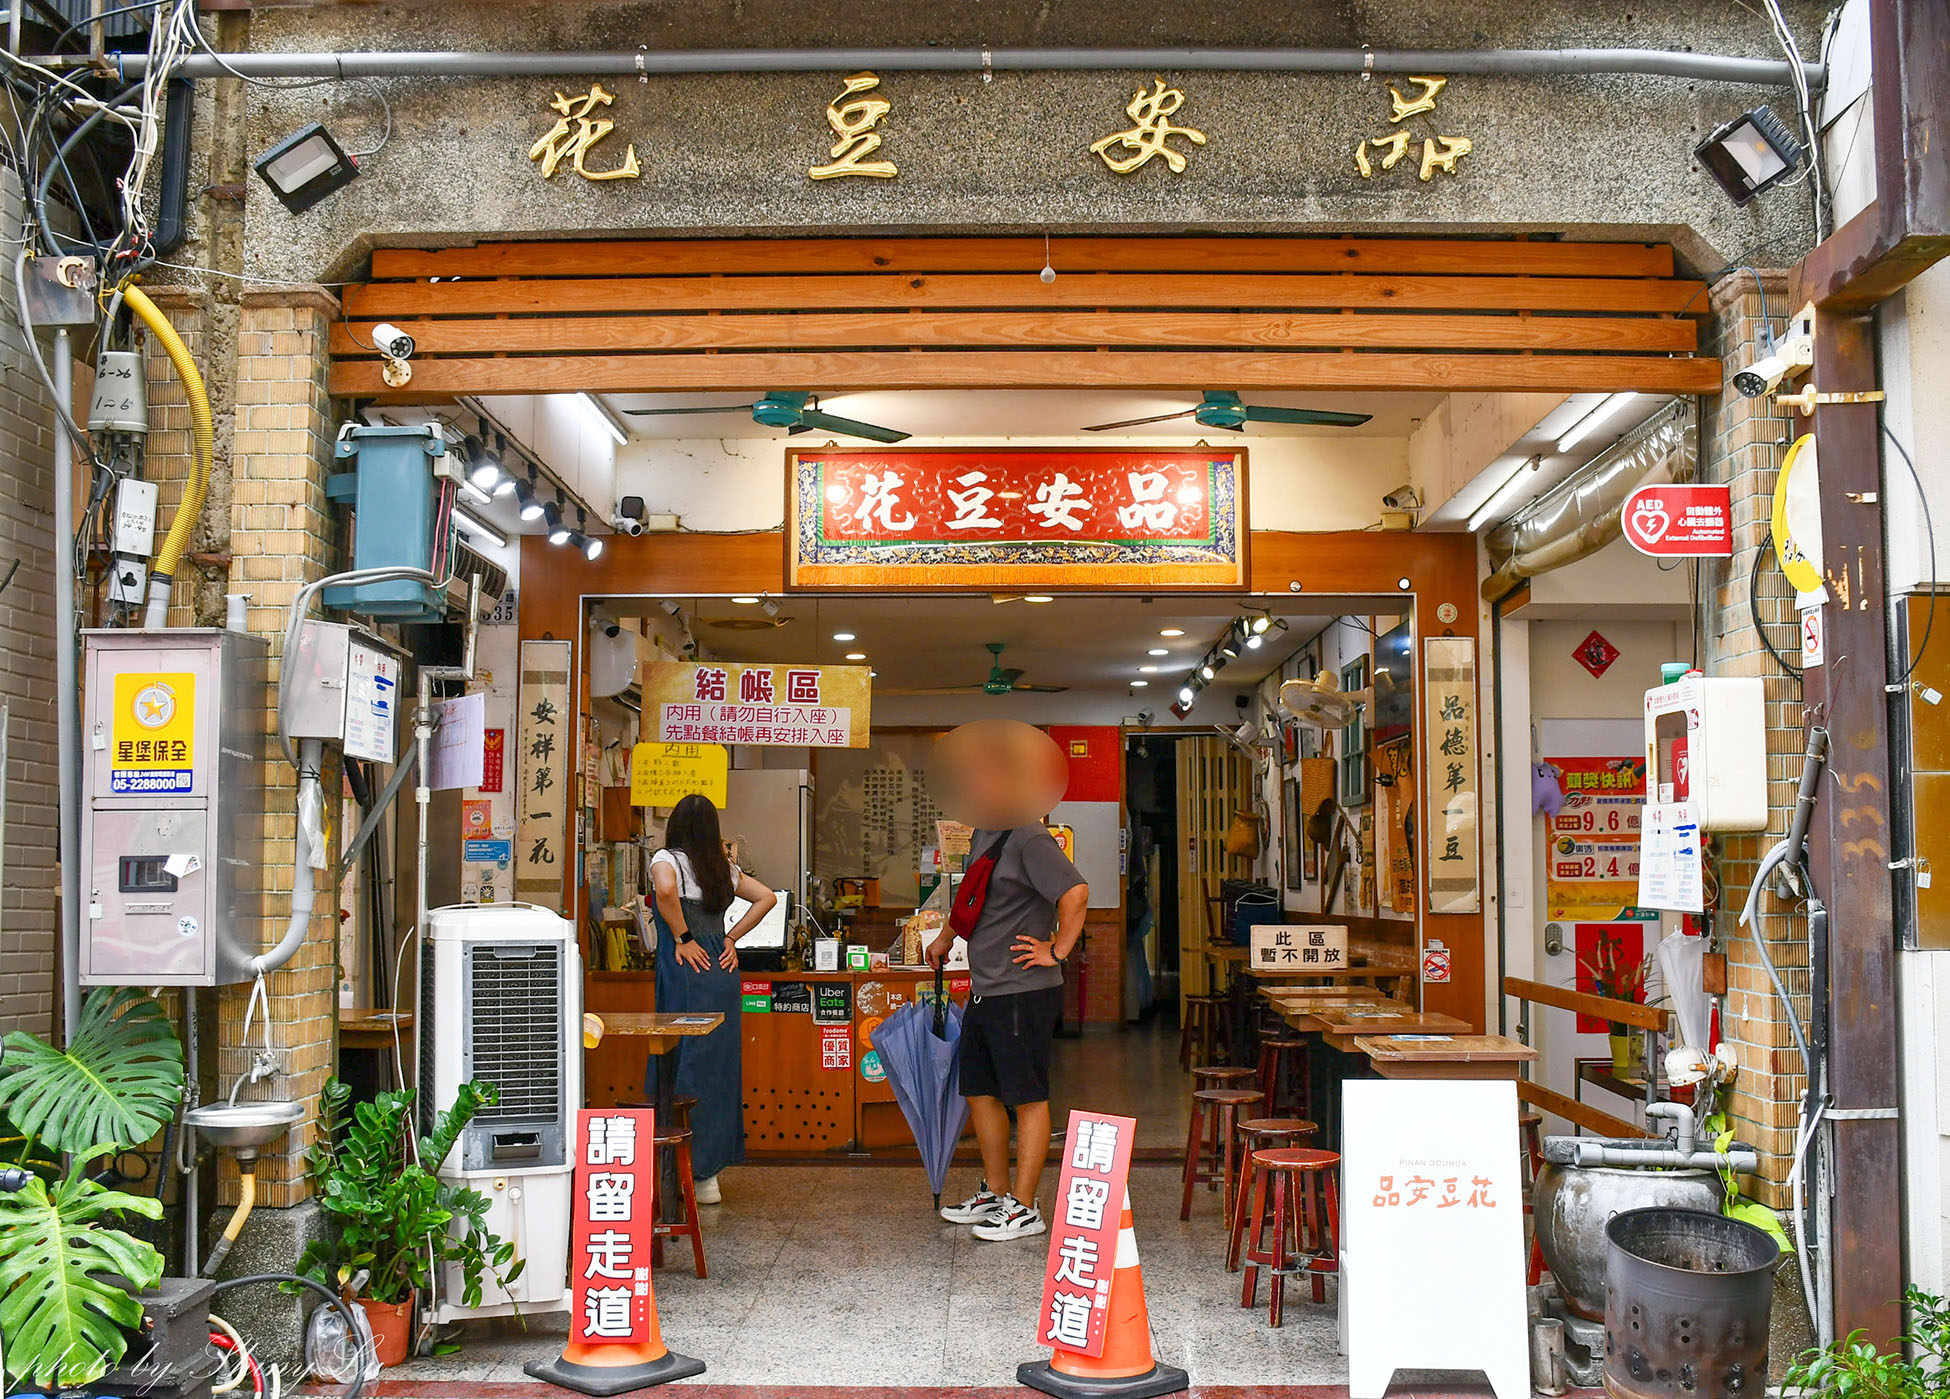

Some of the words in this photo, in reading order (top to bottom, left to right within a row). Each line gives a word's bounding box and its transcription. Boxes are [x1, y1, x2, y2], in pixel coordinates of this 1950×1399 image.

[1636, 499, 1664, 510] AED
[695, 668, 821, 704] 結帳區
[666, 724, 845, 745] 先點餐結帳再安排入座
[118, 740, 187, 762] 星堡保全
[113, 778, 176, 790] 05-2288000
[1566, 772, 1633, 790] 頭獎快訊
[1275, 931, 1326, 947] 此區
[1260, 948, 1341, 963] 暫不開放
[820, 987, 845, 997] Uber
[773, 1002, 810, 1012] 特約商店
[820, 998, 845, 1007] Eats
[824, 1039, 849, 1052] 優質
[824, 1055, 849, 1067] 商家
[1372, 1175, 1497, 1208] 品安豆花
[583, 1115, 637, 1338] 請留走道
[1046, 1119, 1120, 1349] 請留走道
